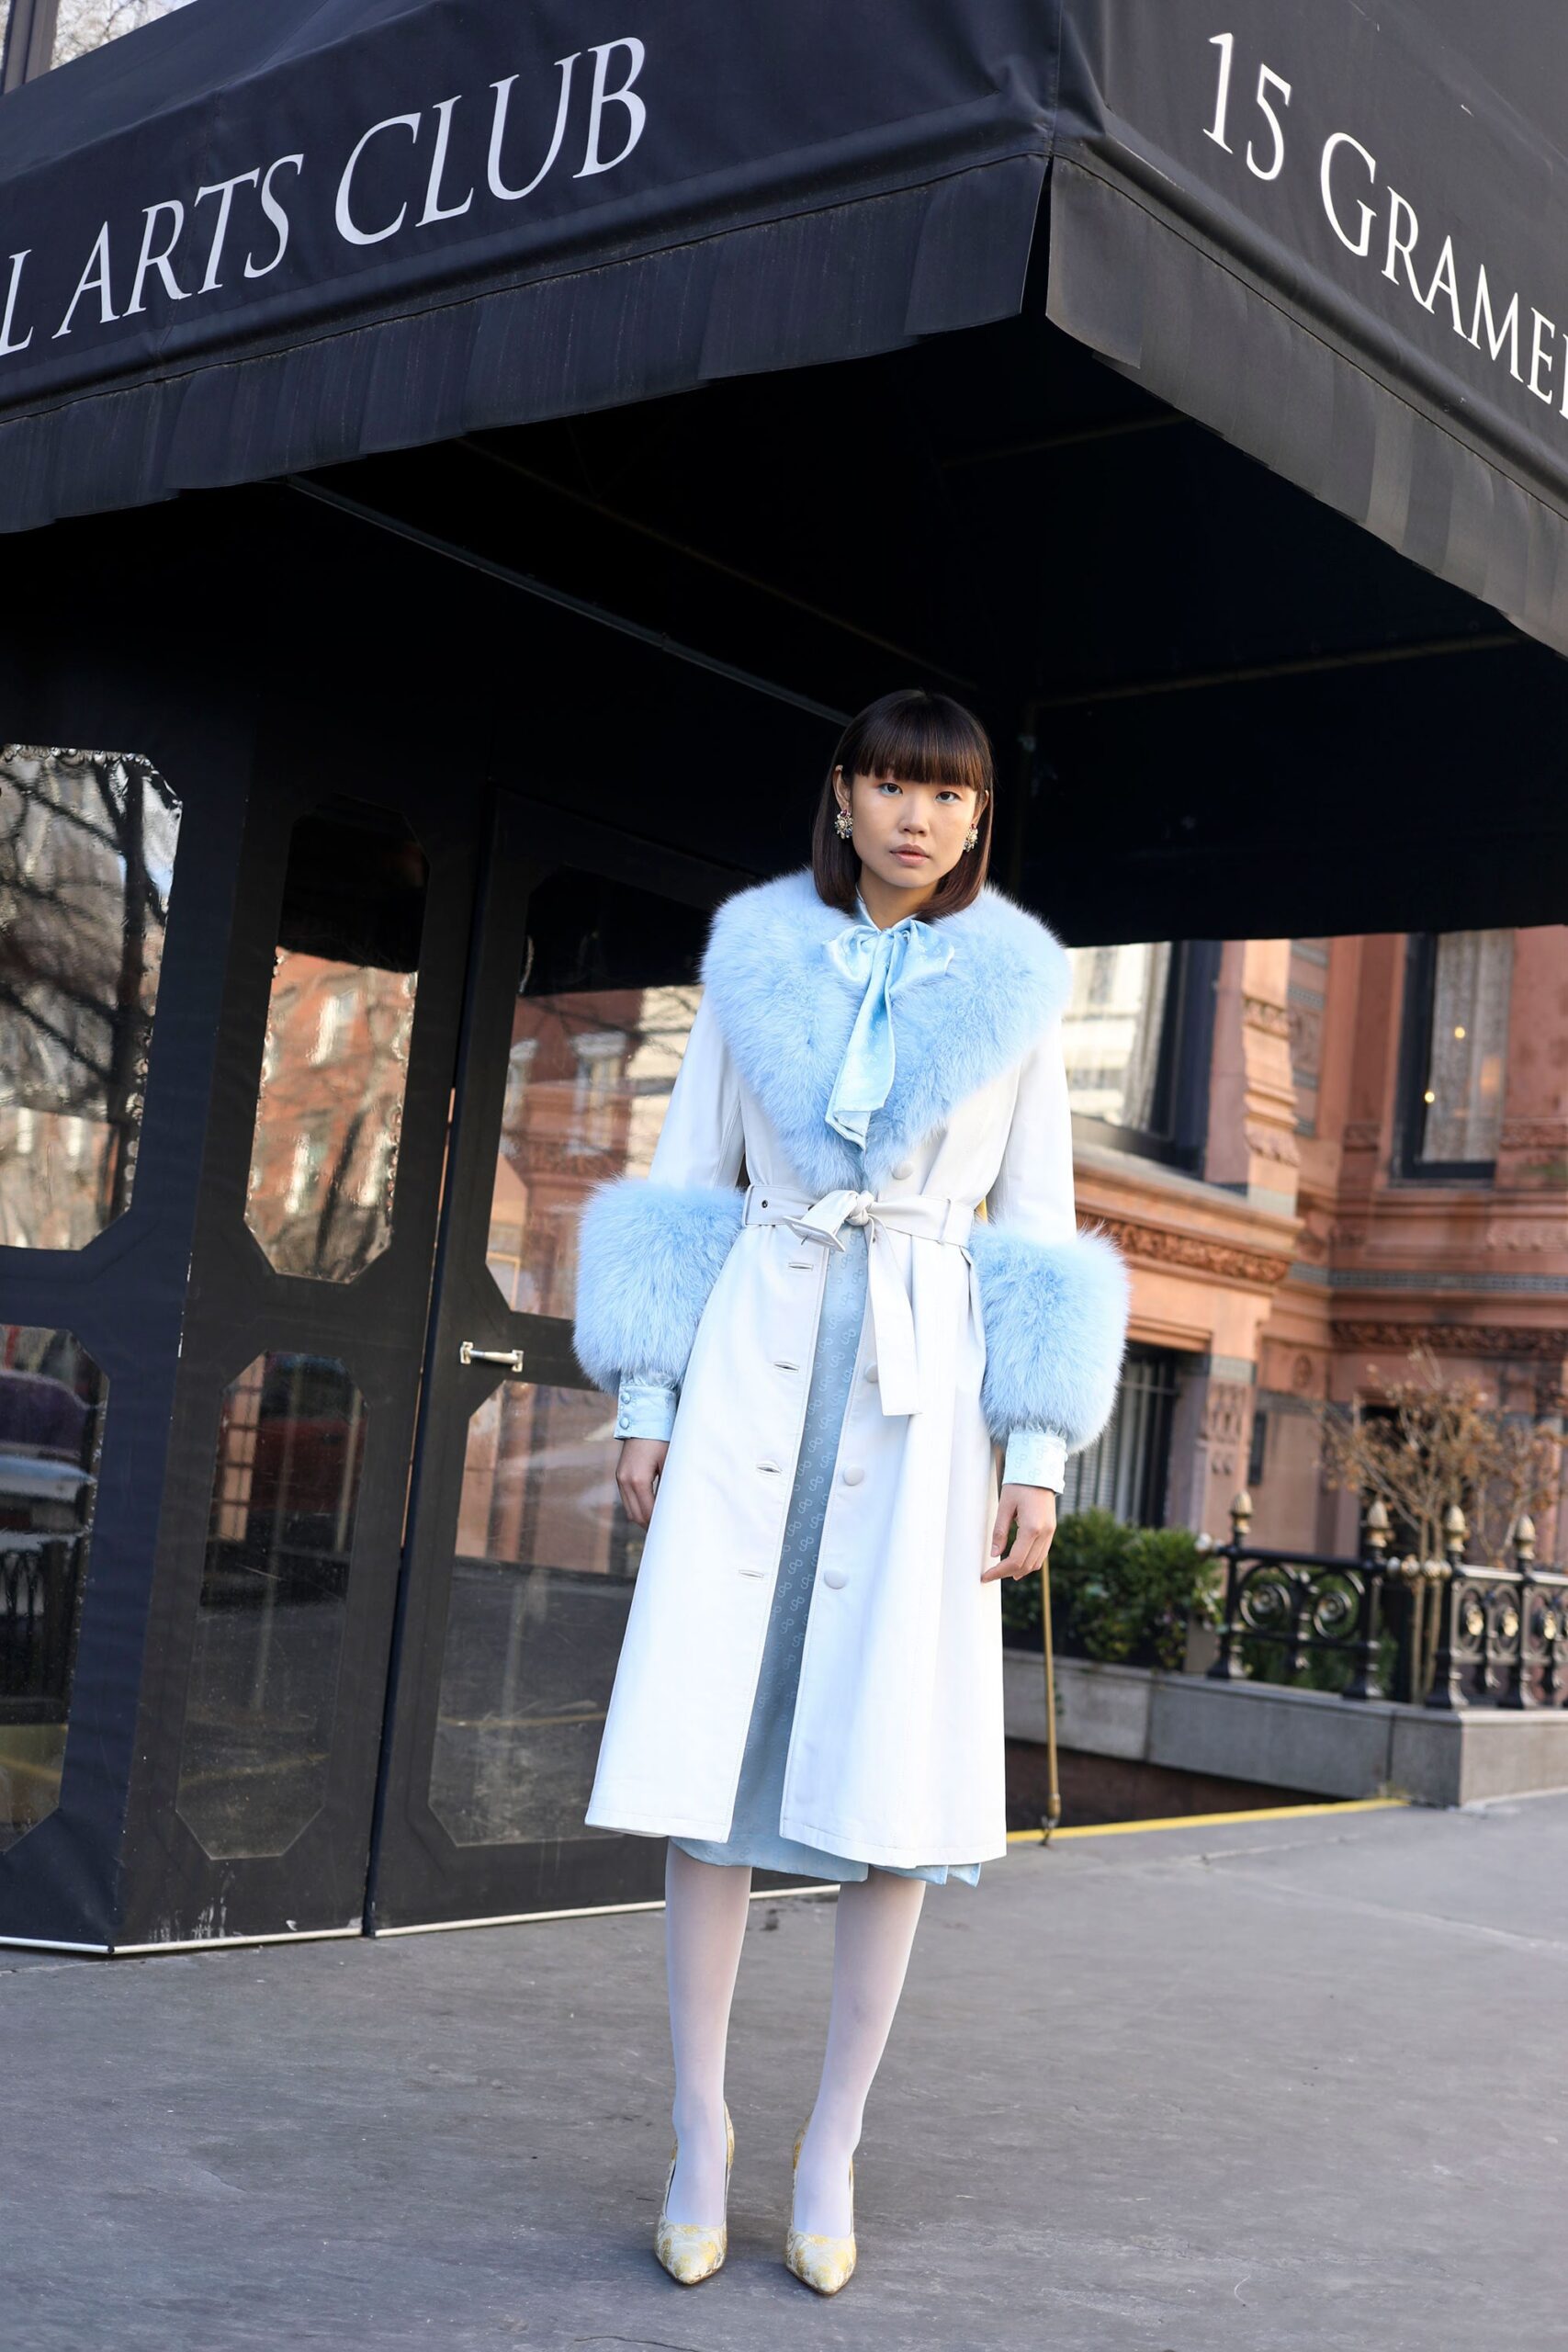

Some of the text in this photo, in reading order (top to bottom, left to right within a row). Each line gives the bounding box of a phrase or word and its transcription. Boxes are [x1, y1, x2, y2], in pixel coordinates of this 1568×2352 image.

[51, 153, 304, 340] ARTS
[334, 37, 647, 245] CLUB
[1202, 32, 1568, 420] 15 GRAME
